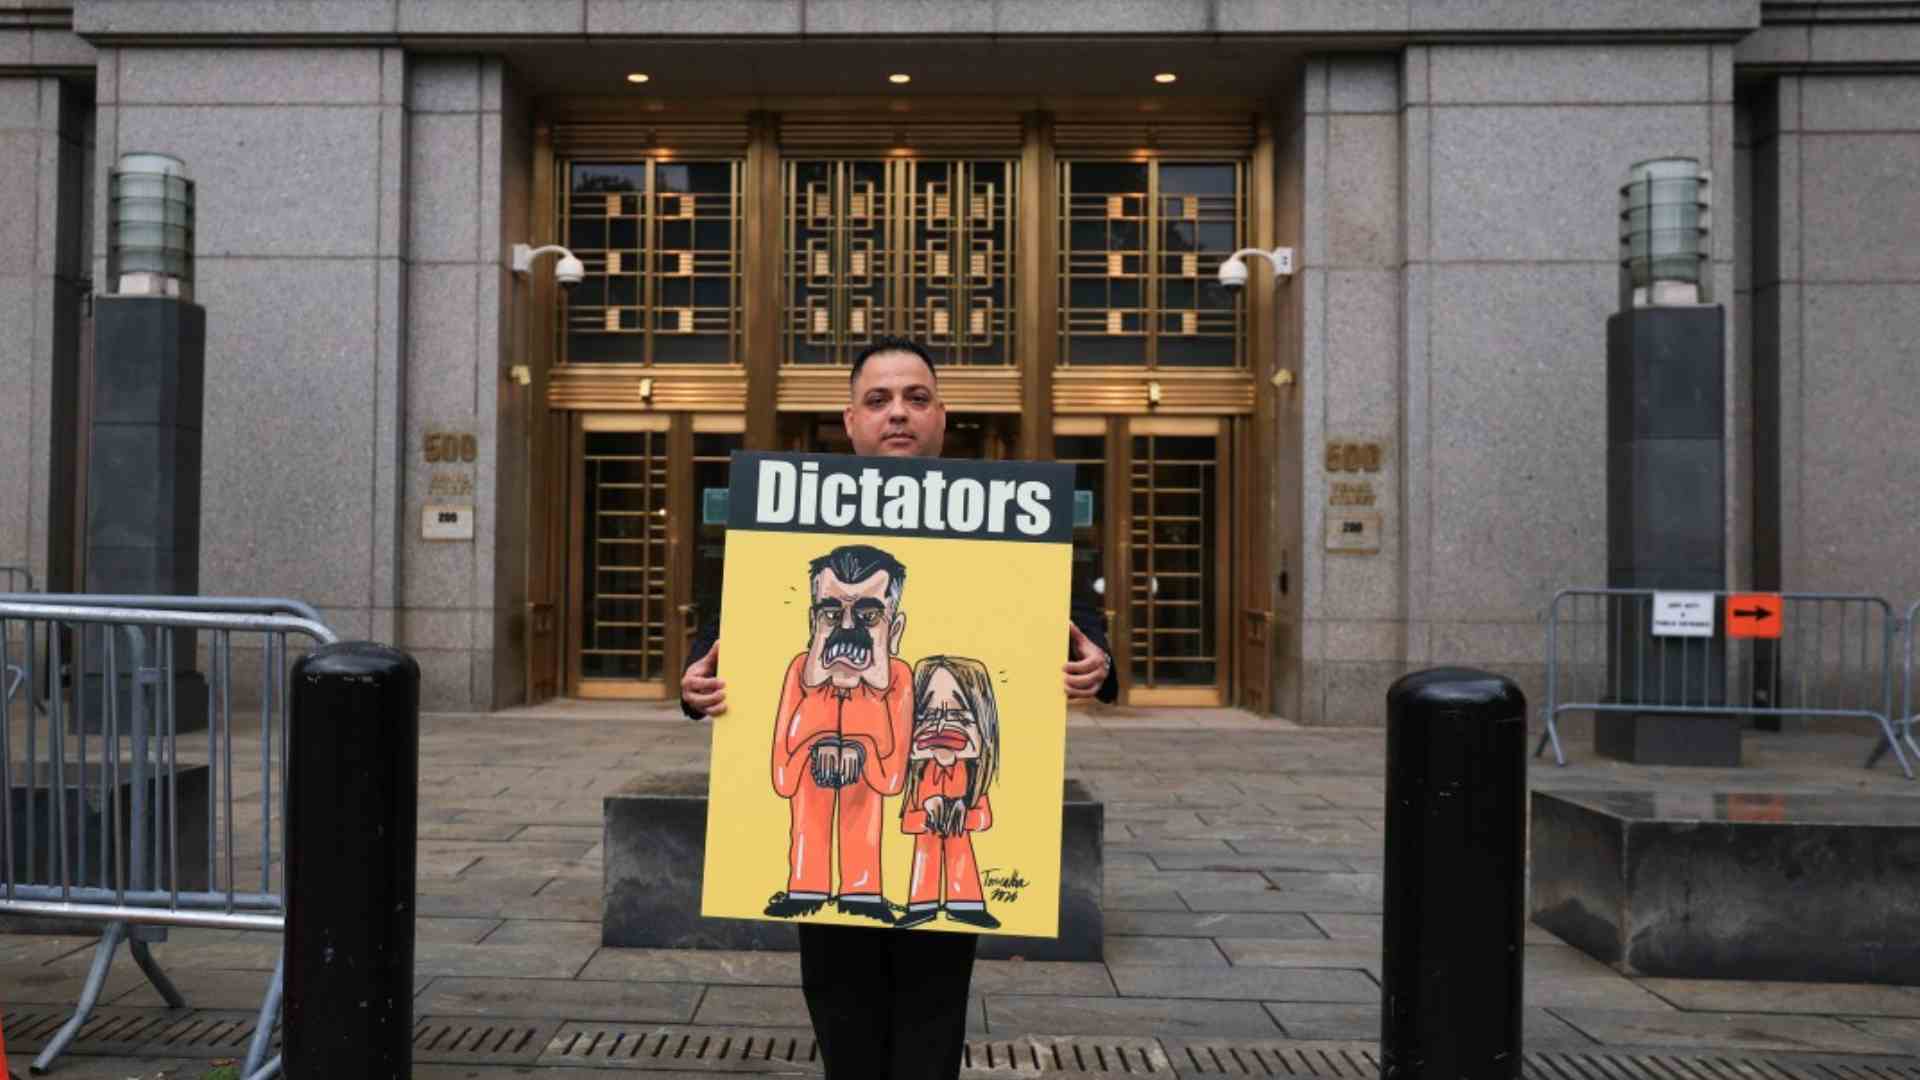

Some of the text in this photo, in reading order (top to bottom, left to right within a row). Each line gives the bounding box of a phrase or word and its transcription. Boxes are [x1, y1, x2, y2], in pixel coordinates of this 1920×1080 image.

[424, 432, 477, 462] 500
[1326, 442, 1380, 472] 500
[756, 459, 1051, 535] Dictators
